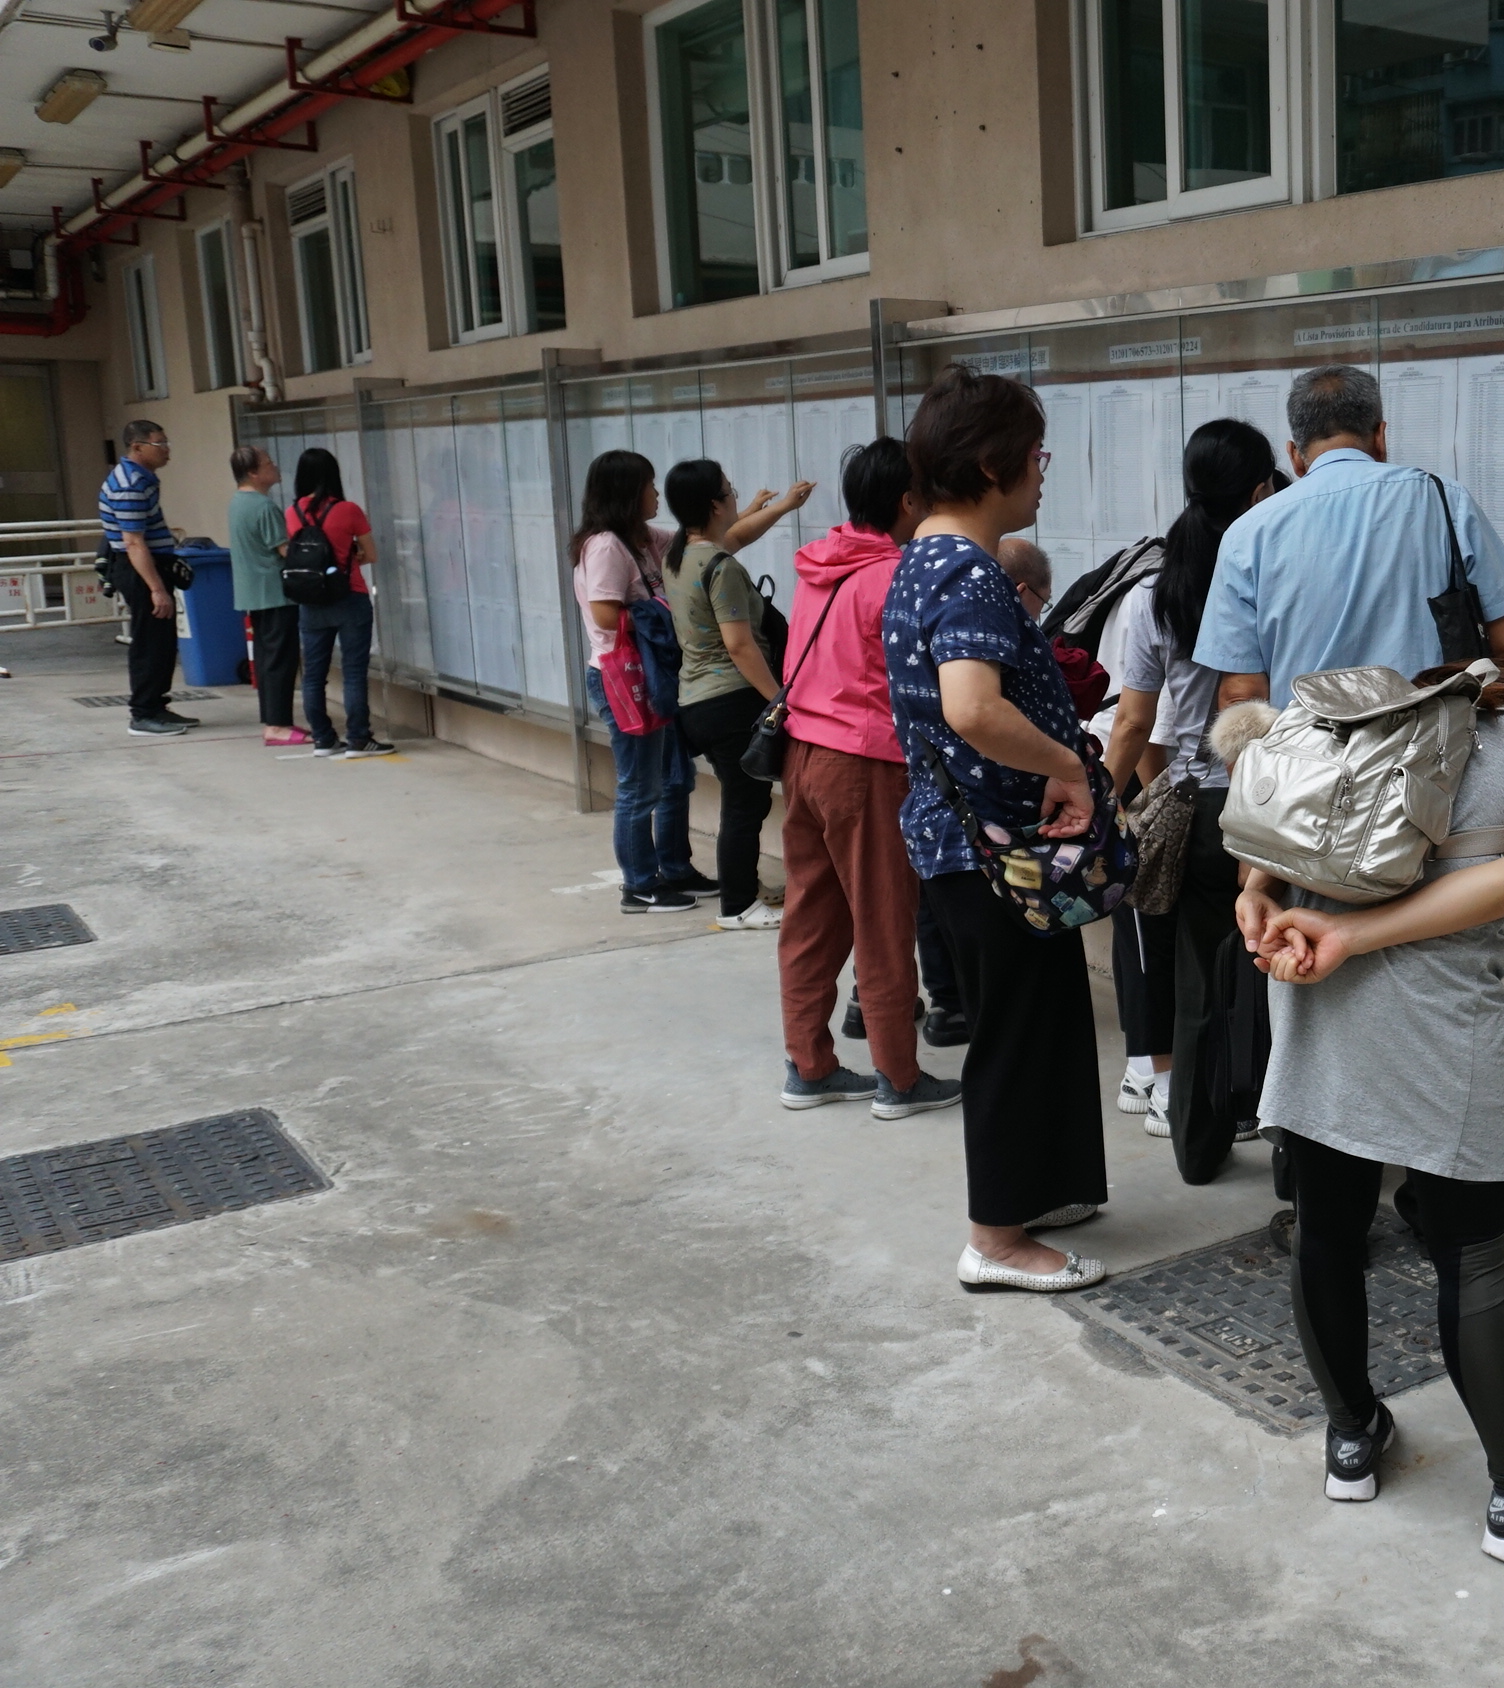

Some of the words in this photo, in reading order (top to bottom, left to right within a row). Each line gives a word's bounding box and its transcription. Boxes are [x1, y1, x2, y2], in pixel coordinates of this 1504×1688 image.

[1303, 331, 1319, 341] Lista
[1320, 328, 1354, 340] Provisória
[1356, 326, 1365, 336] de
[1392, 323, 1401, 333] de
[1404, 319, 1451, 333] Candidatura
[1453, 319, 1471, 331] para
[1341, 1442, 1361, 1452] NIKE
[1342, 1458, 1359, 1466] AIR
[1490, 1513, 1504, 1523] AIR
